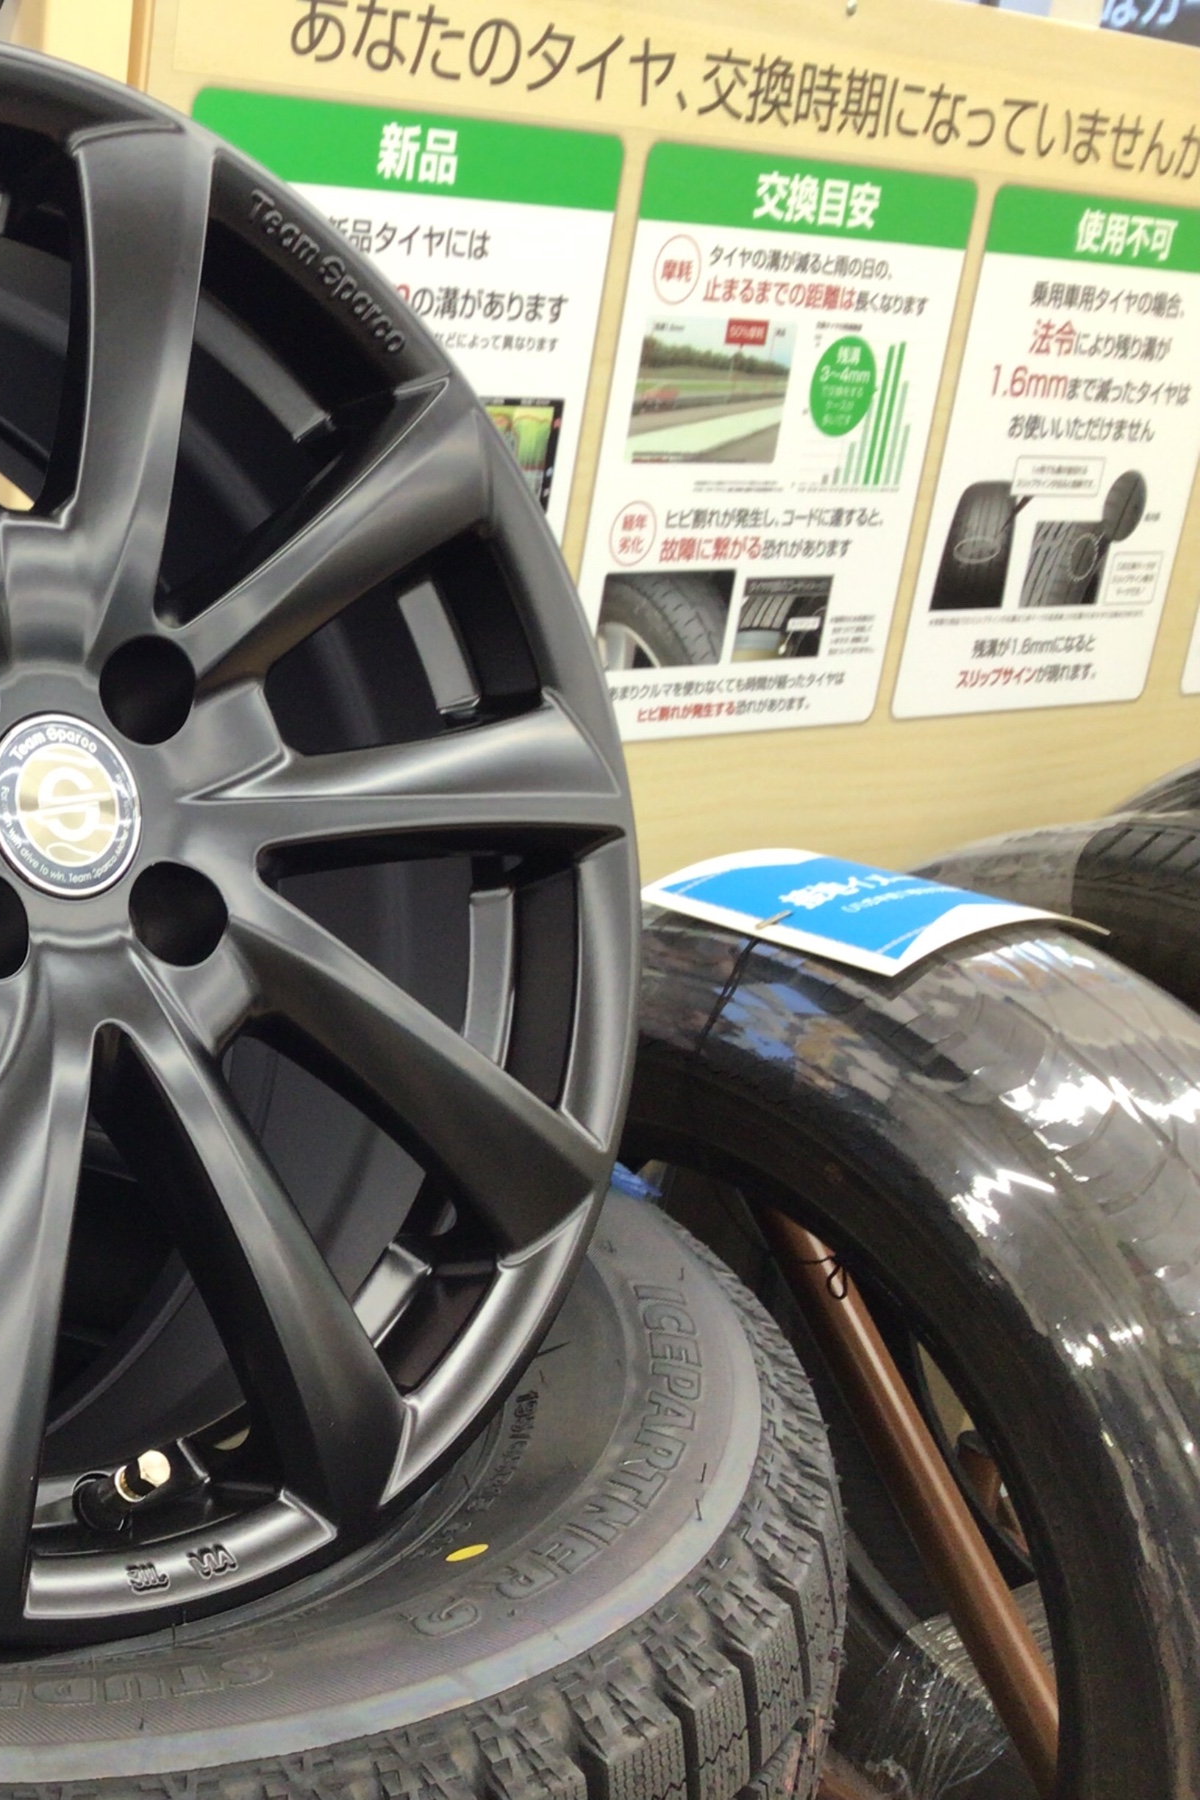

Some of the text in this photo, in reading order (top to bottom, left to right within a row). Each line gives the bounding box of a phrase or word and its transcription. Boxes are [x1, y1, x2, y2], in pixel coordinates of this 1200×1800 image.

[377, 122, 459, 186] 新品
[753, 171, 882, 230] 交換目安
[1074, 208, 1178, 262] 使用不可
[251, 189, 407, 352] Team Sparco
[660, 258, 693, 283] 摩耗
[703, 275, 930, 316] 止まるまでの距離は長くなります
[1029, 318, 1173, 362] 法令により残り溝が
[991, 363, 1192, 406] 1.6mmまで減ったタイヤは
[1008, 413, 1156, 442] お使いいただけません
[622, 514, 648, 531] 経年
[618, 538, 644, 555] 劣化
[8, 727, 98, 761] Team Sparco
[497, 1284, 702, 1599] ICEPARTNER
